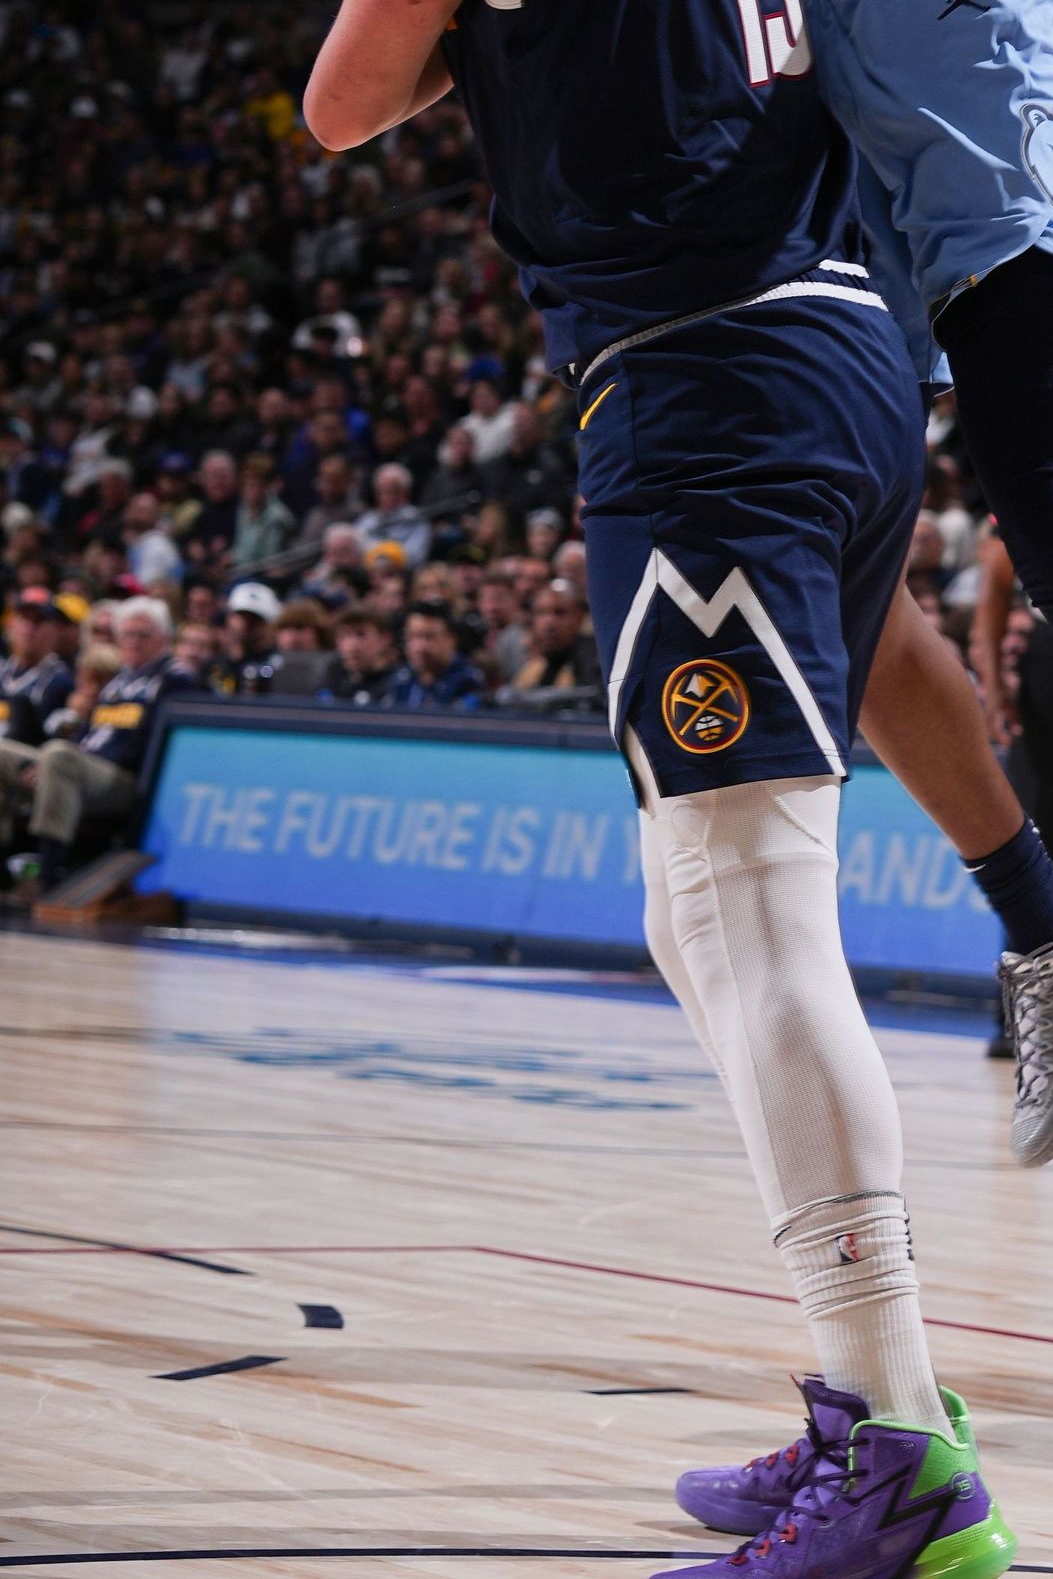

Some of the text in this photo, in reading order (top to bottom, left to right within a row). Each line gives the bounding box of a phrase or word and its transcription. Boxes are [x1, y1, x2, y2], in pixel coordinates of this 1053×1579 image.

[179, 782, 274, 853] THE
[274, 788, 482, 871] FUTURE
[481, 805, 542, 877] IS
[542, 809, 610, 881] IN
[841, 829, 992, 914] AND
